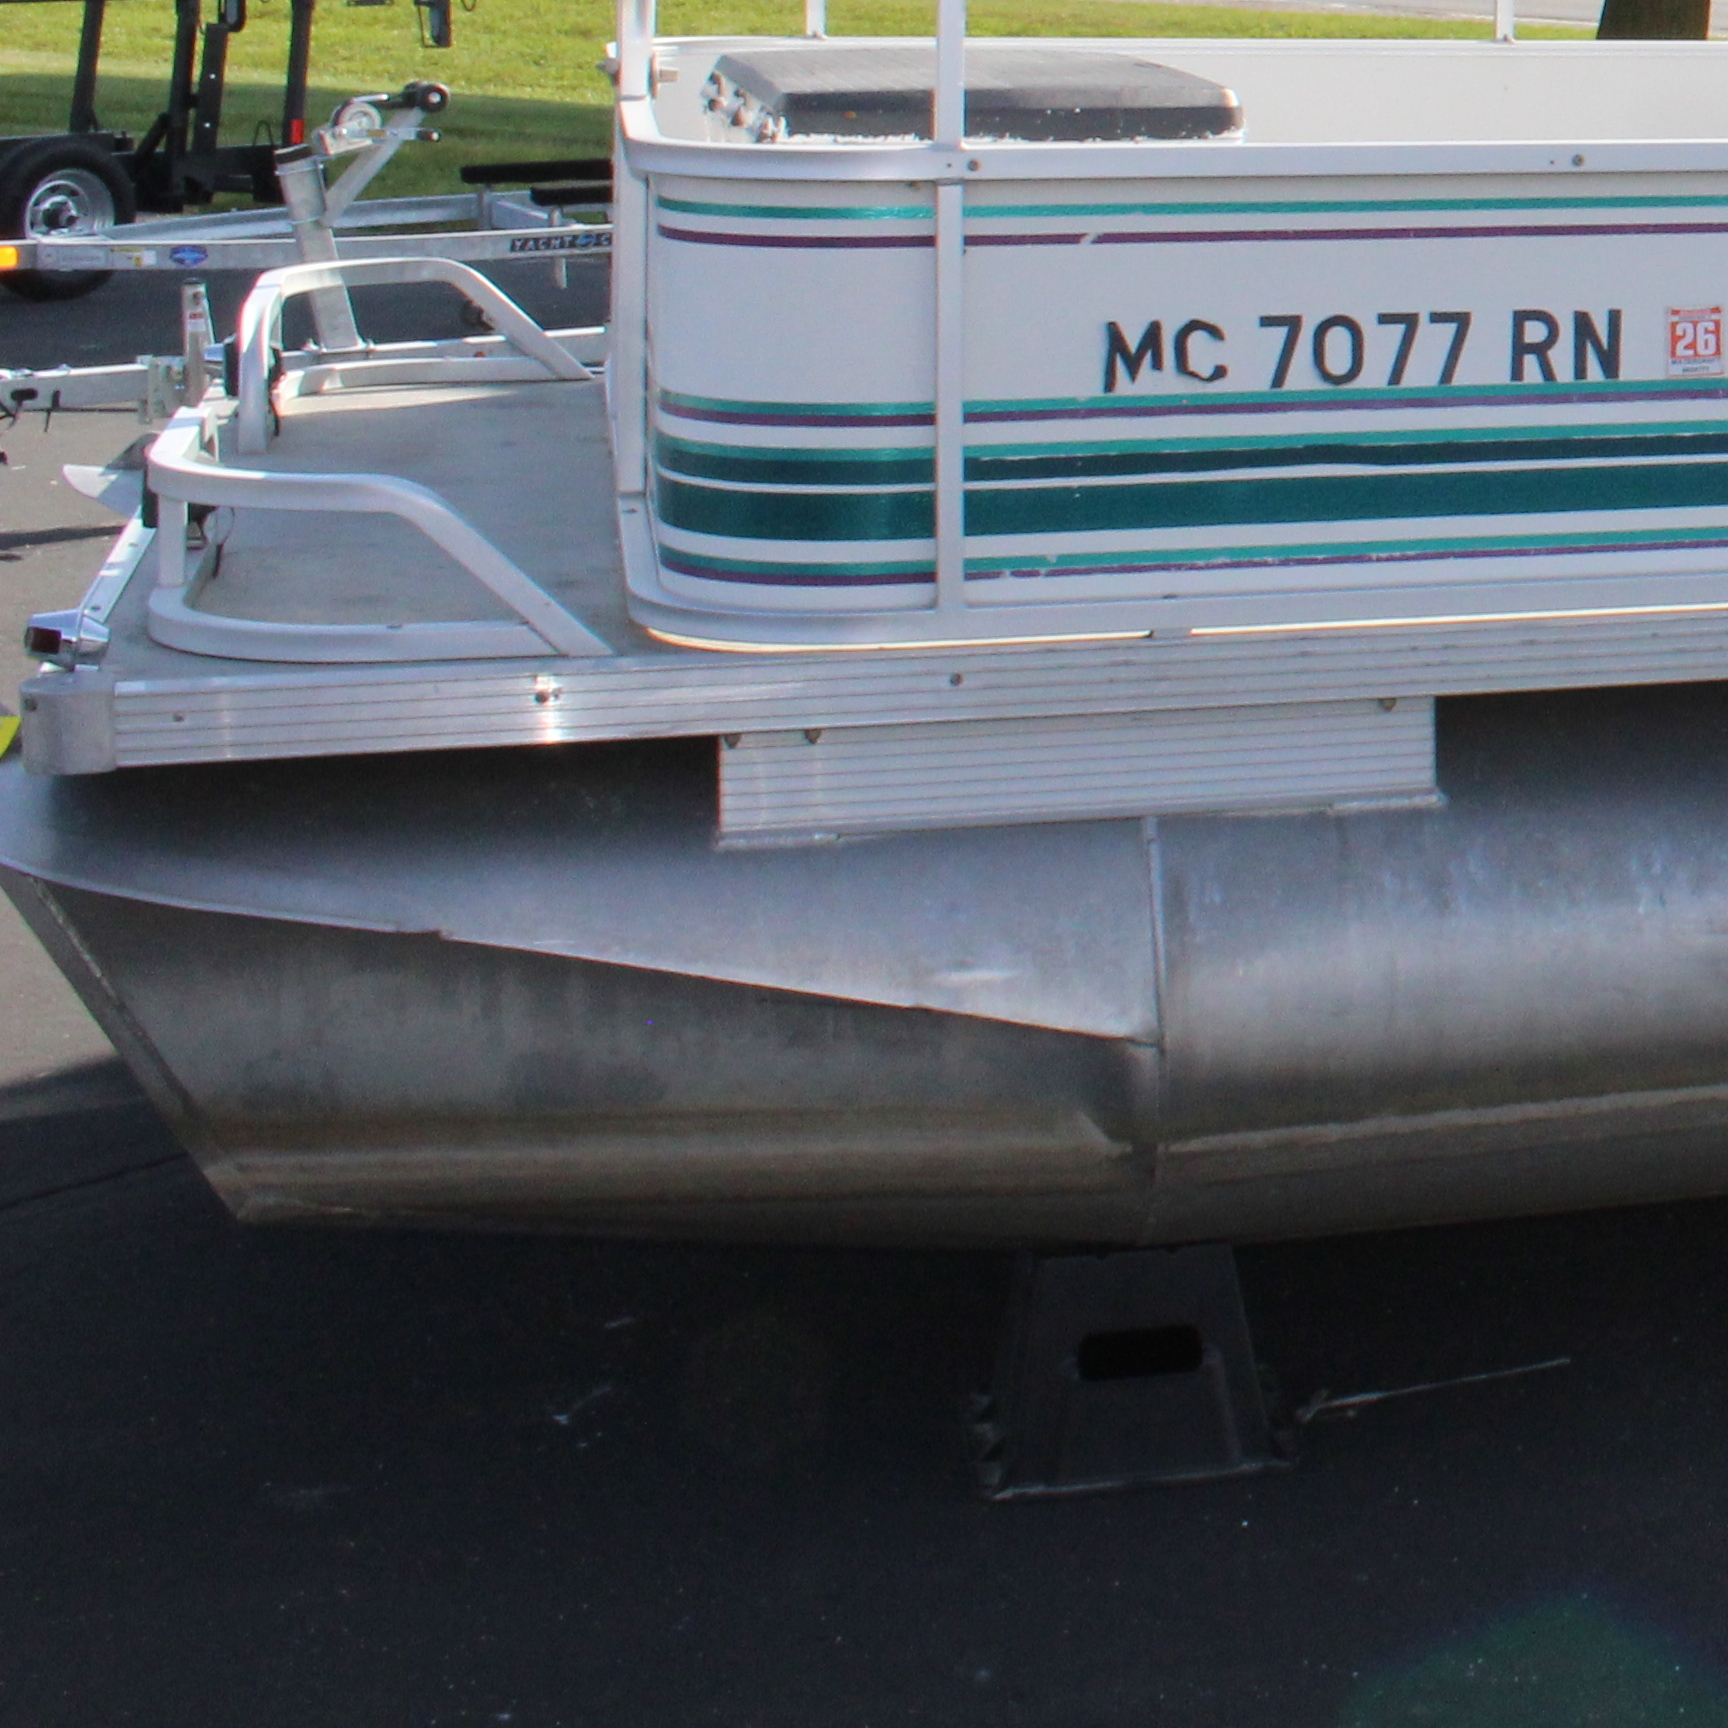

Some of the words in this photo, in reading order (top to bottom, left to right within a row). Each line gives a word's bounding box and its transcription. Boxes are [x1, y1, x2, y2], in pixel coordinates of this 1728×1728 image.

[511, 236, 573, 251] YACHT
[1103, 318, 1229, 394] MC
[1259, 311, 1472, 390] 7077
[1510, 308, 1623, 383] RN
[1675, 320, 1717, 357] 26
